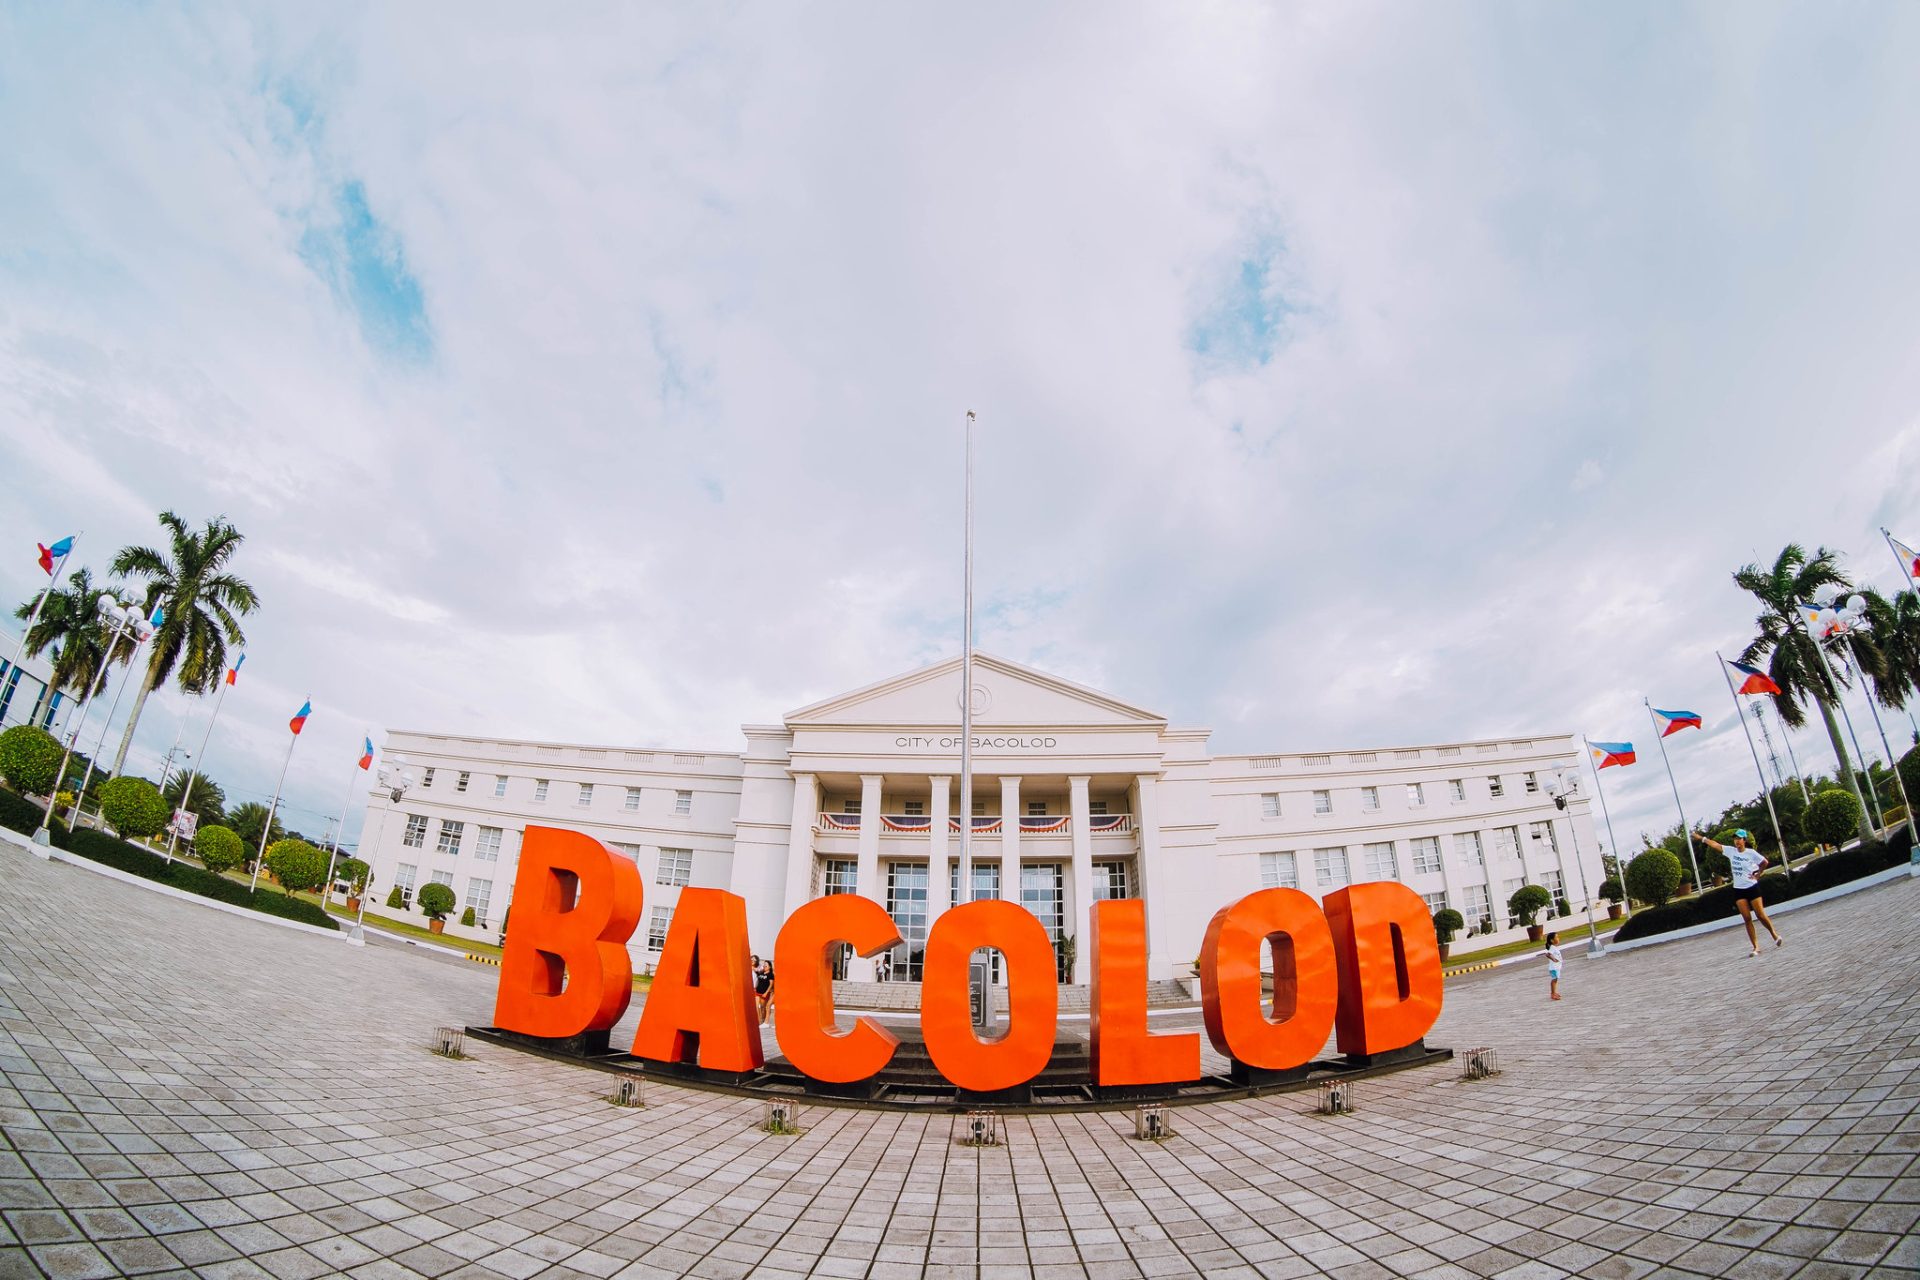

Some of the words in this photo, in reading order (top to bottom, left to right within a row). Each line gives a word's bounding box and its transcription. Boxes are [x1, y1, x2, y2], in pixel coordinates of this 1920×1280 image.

[895, 737, 934, 748] CITY
[939, 737, 964, 748] OF
[970, 737, 1057, 748] BACOLOD
[493, 825, 1443, 1091] BACOLOD
